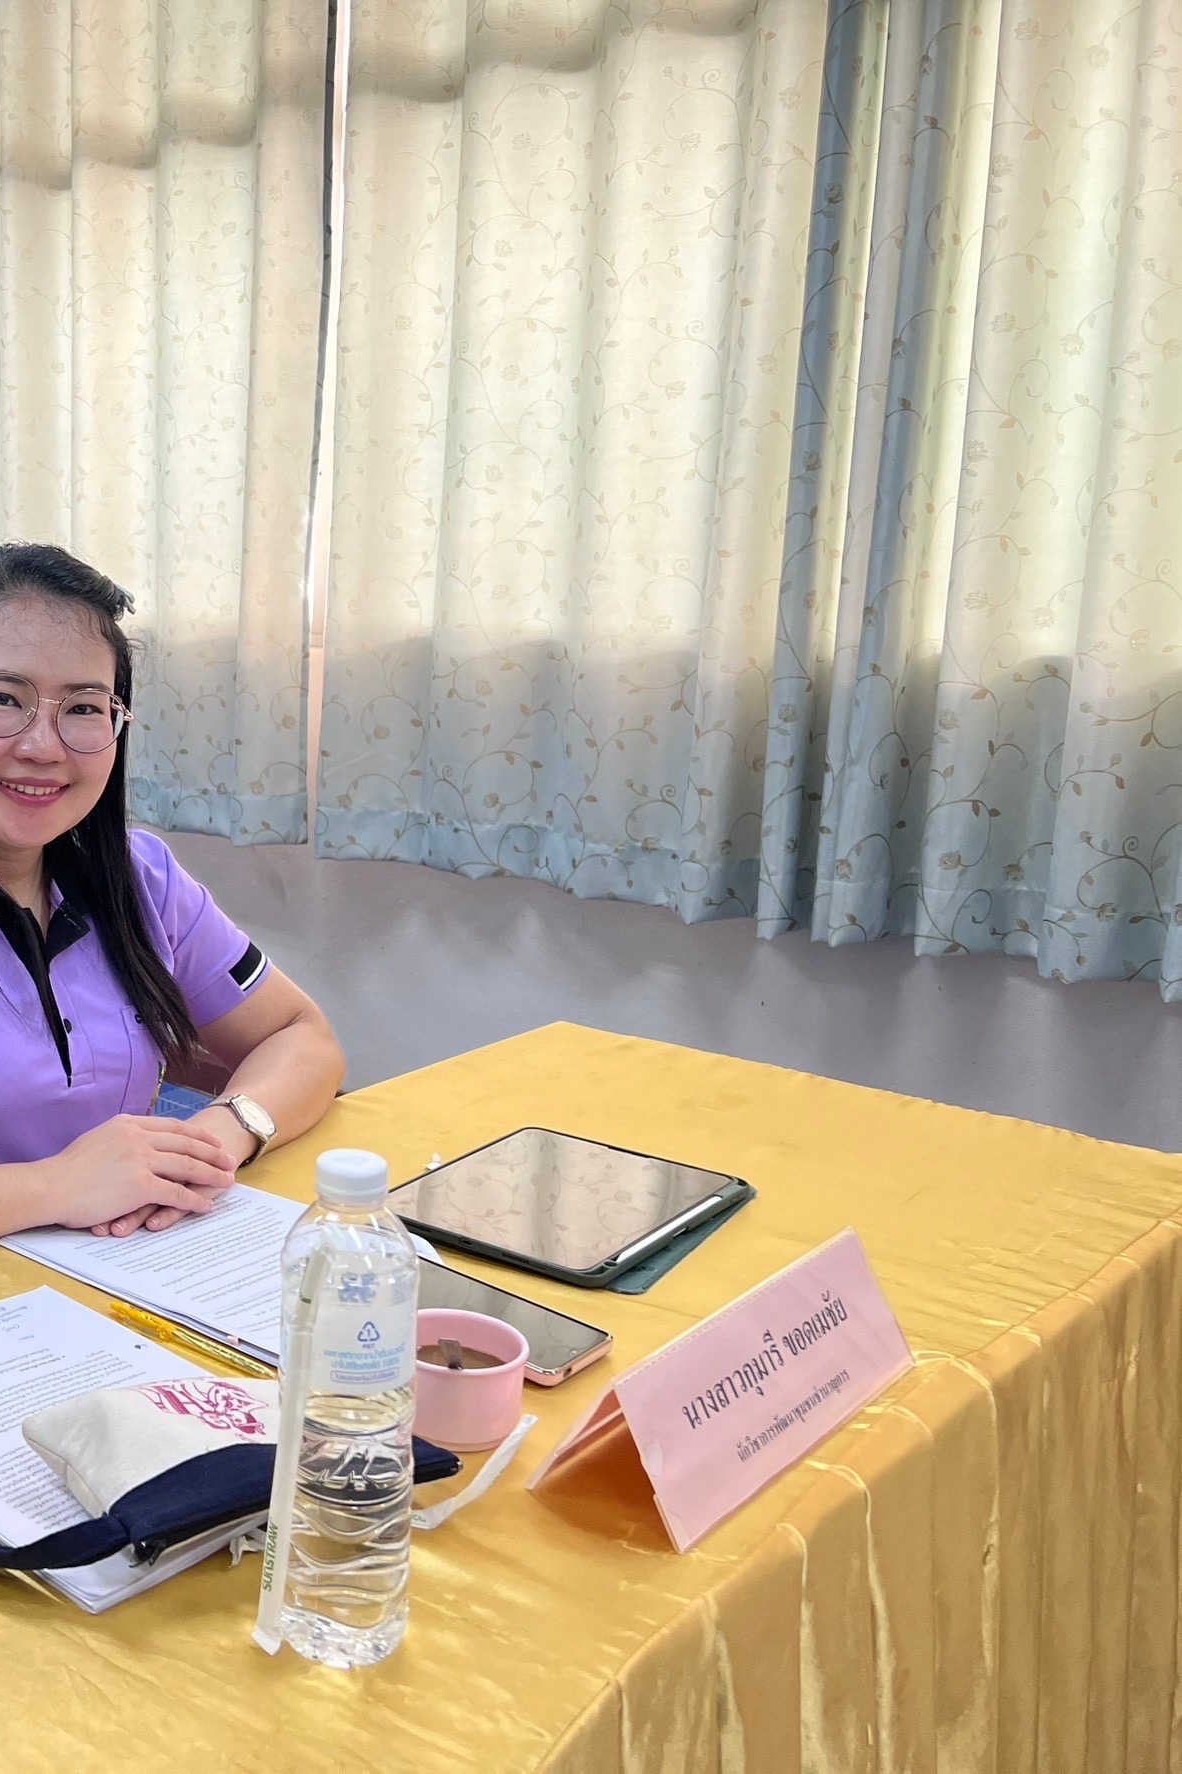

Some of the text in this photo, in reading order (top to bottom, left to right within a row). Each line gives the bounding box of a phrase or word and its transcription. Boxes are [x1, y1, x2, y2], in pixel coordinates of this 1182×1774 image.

[682, 1290, 848, 1429] นางสาวกุมารี ขอดเมชัย
